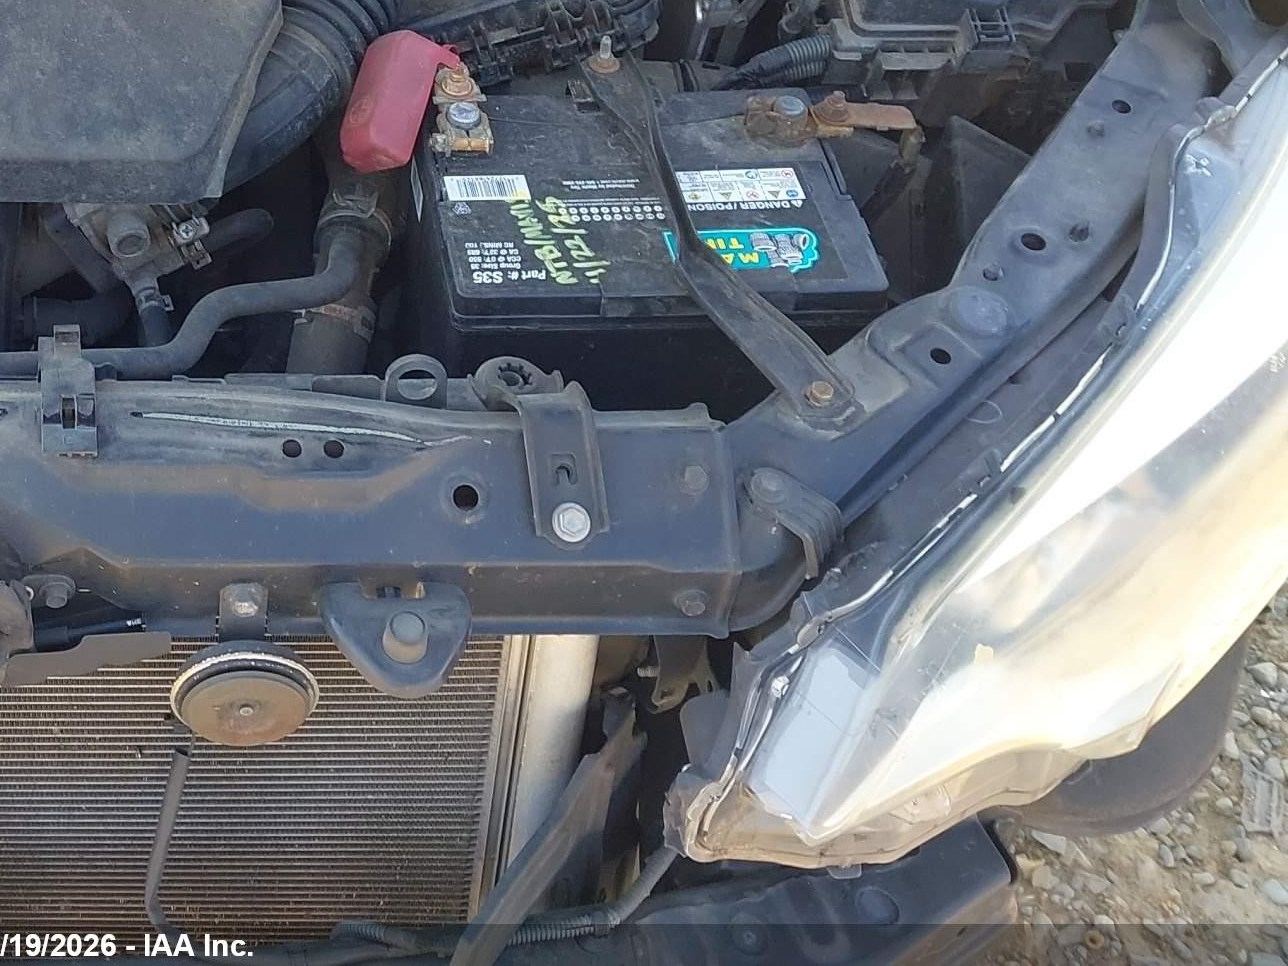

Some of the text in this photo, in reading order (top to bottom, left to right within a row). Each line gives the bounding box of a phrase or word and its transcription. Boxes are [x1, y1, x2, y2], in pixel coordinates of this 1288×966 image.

[687, 201, 733, 212] POISON
[739, 200, 790, 210] DANGER
[472, 269, 546, 284] Part #: S35
